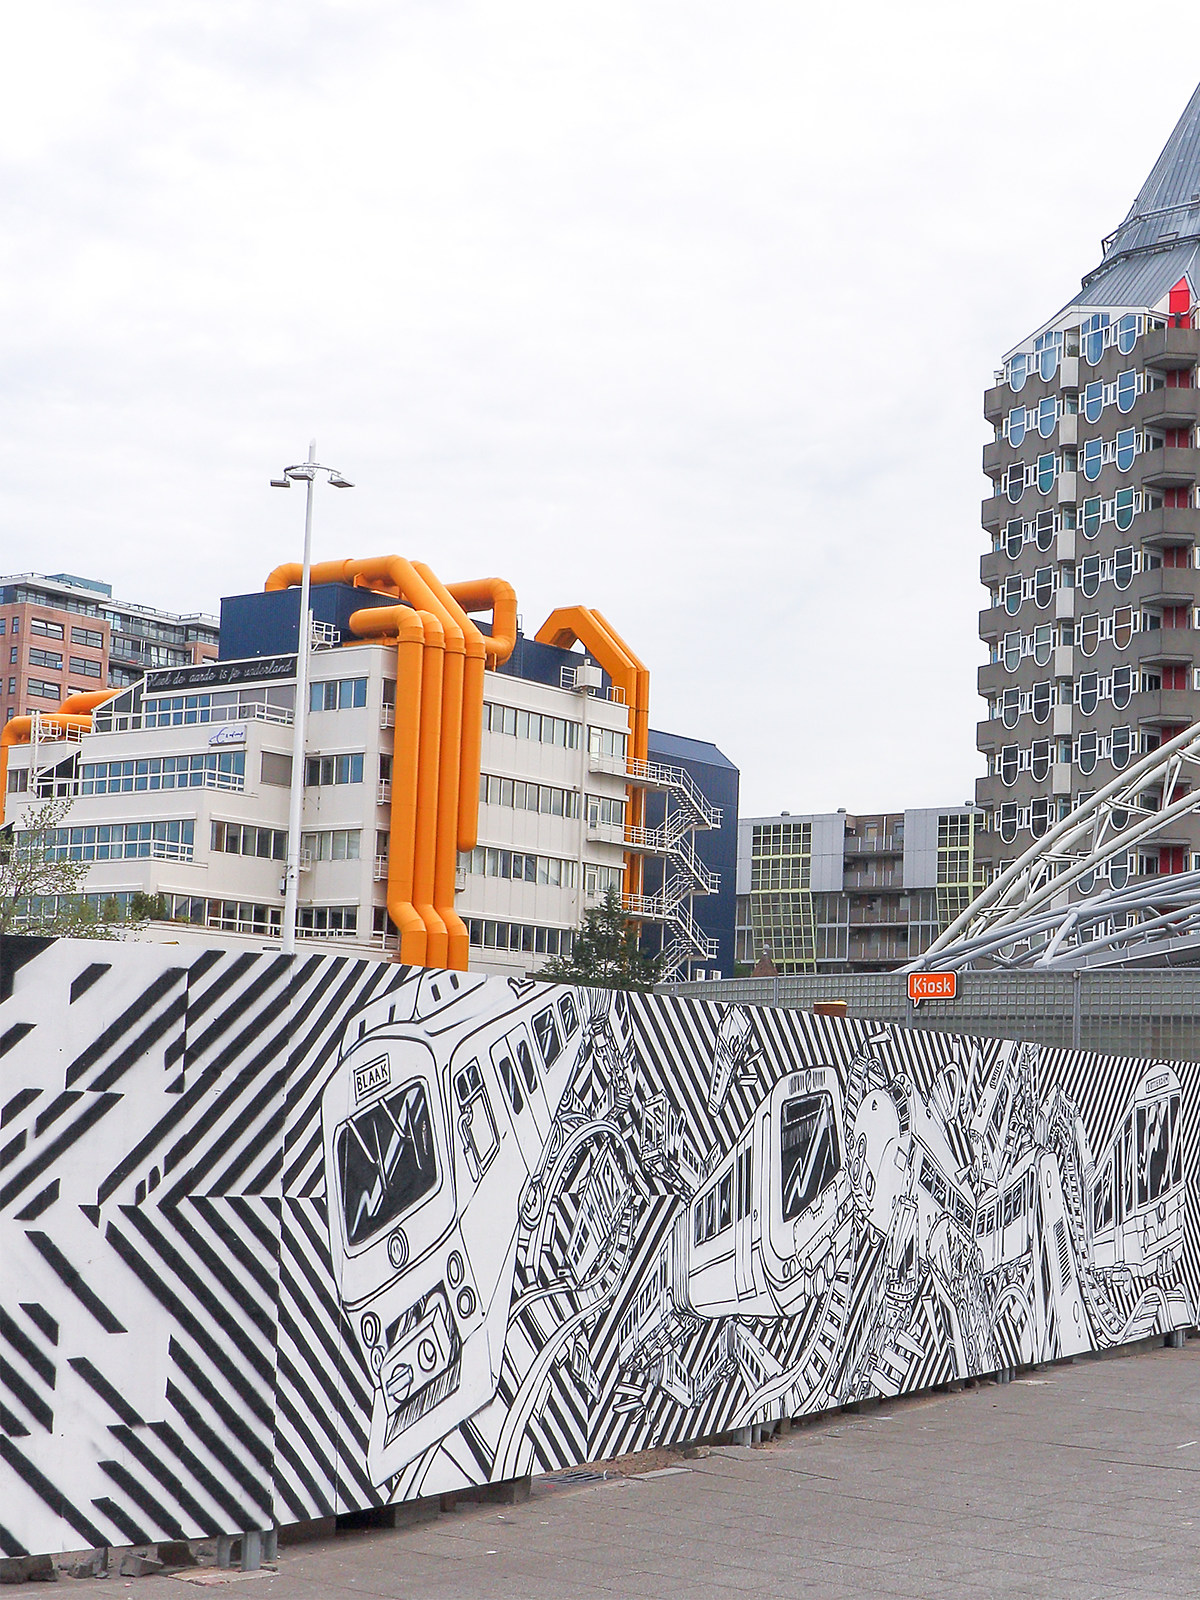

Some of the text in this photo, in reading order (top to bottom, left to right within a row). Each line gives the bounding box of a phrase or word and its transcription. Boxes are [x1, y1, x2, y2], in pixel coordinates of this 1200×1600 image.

[172, 671, 185, 685] de
[189, 668, 216, 683] aarde
[219, 669, 228, 680] is
[913, 977, 952, 994] Kiosk
[356, 1063, 388, 1093] BLAAK
